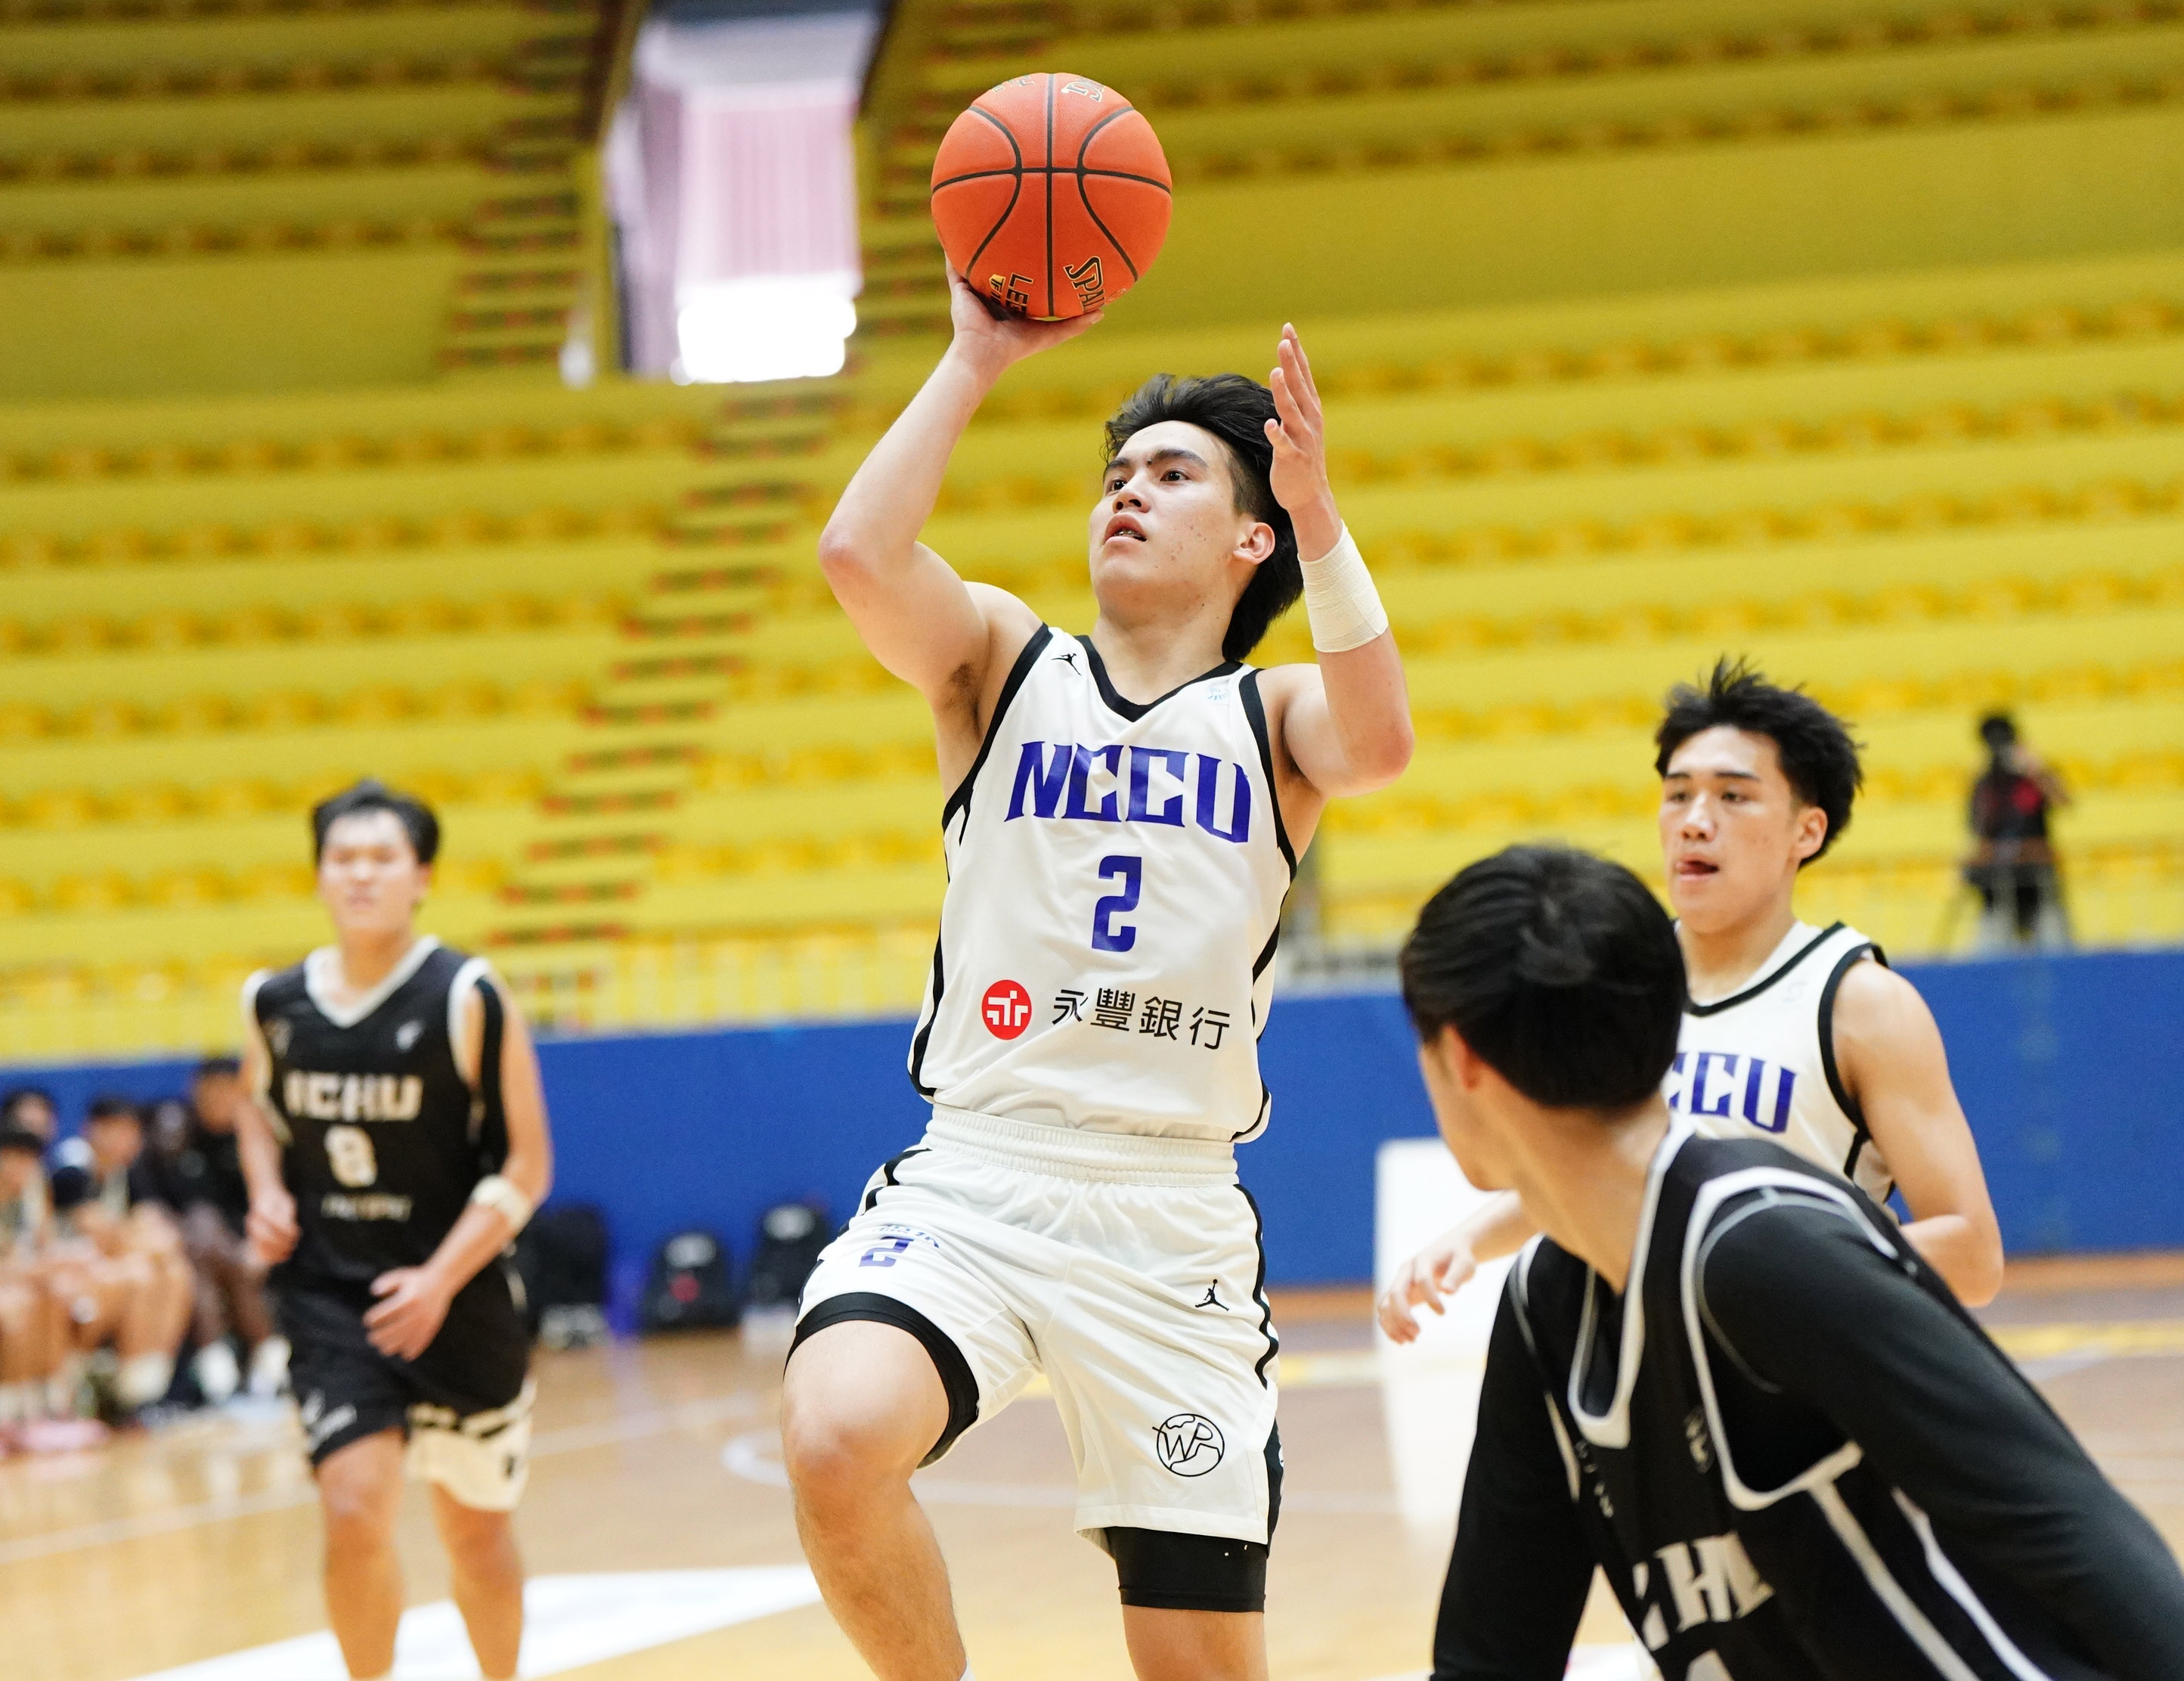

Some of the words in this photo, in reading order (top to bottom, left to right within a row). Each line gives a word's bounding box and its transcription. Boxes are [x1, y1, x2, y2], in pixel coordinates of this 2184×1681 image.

[1004, 740, 1252, 844] NCCU
[1092, 854, 1142, 953] 2
[1052, 988, 1231, 1050] 永豐銀行
